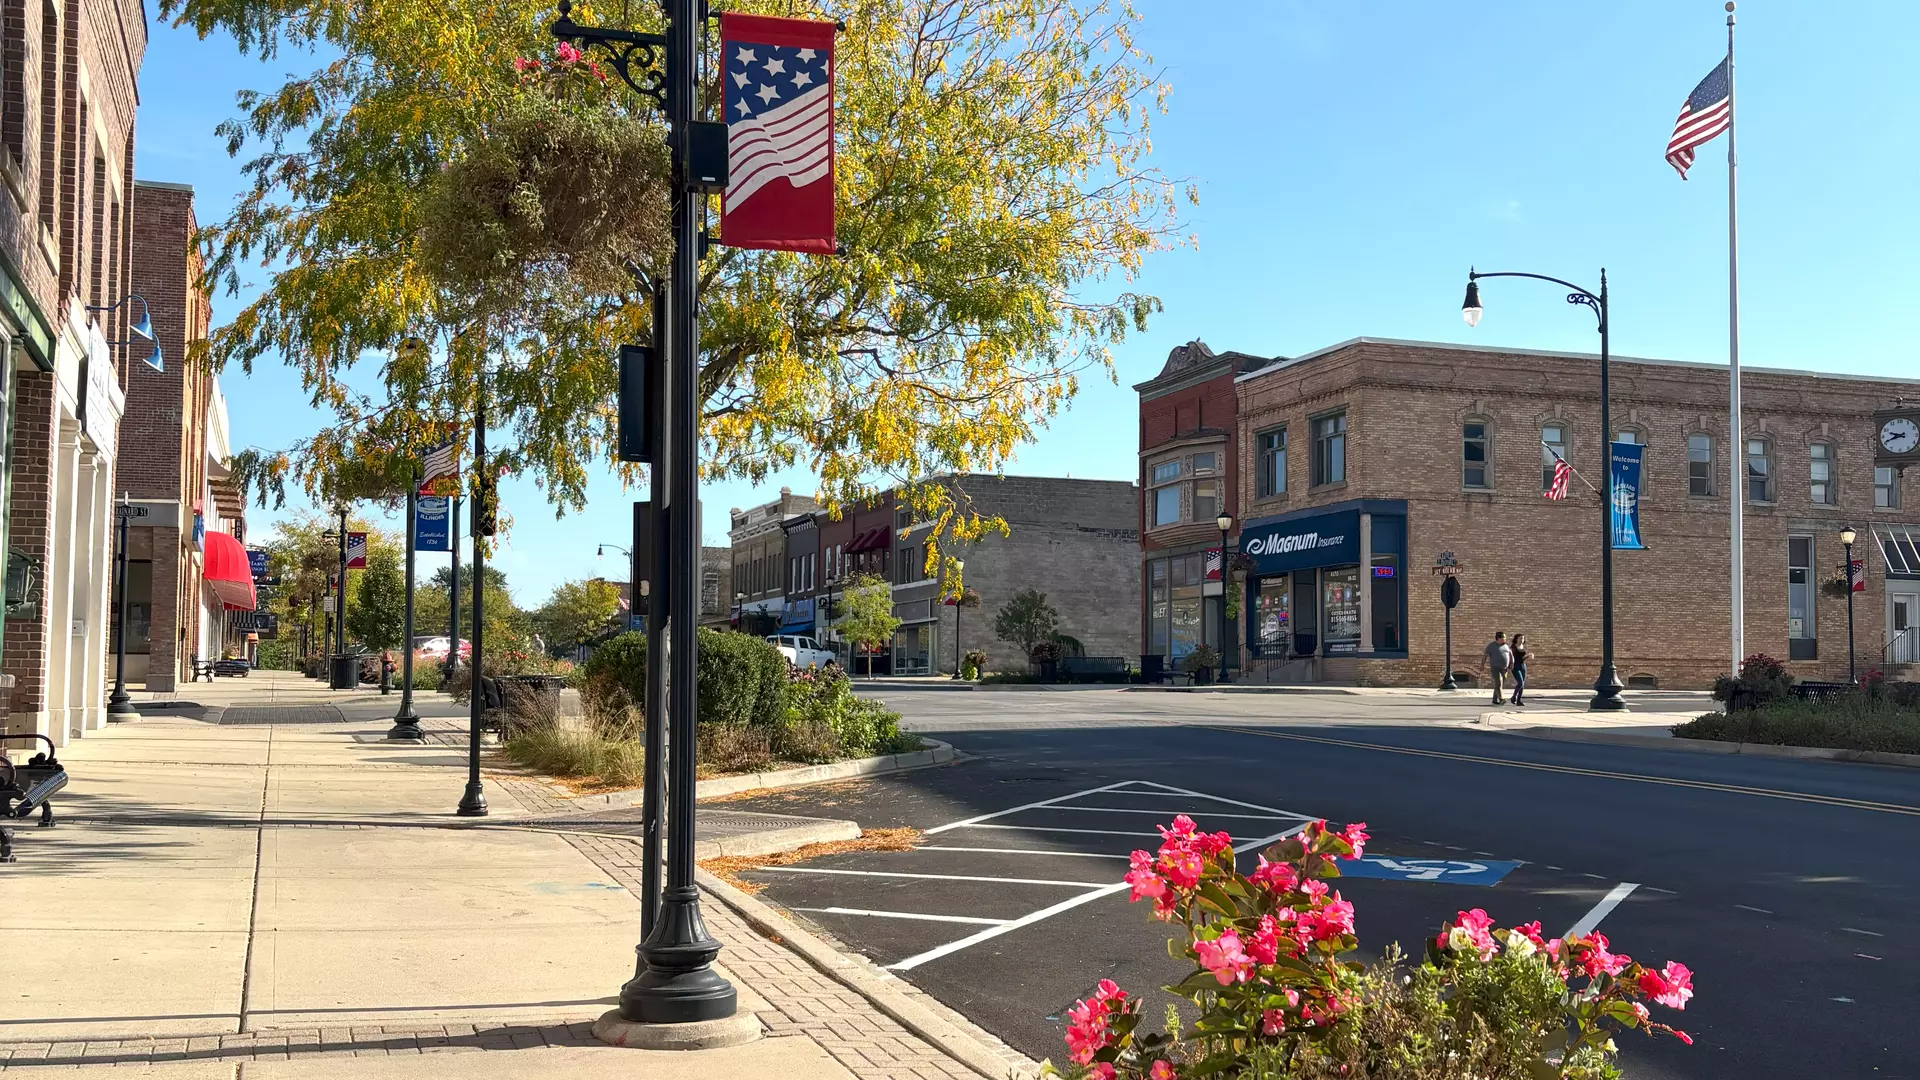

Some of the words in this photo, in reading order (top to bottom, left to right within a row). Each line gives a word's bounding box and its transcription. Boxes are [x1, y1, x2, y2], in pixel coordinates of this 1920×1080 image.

[1612, 455, 1640, 464] Welcome
[1265, 532, 1318, 555] Magnum
[1317, 535, 1344, 548] Insurance
